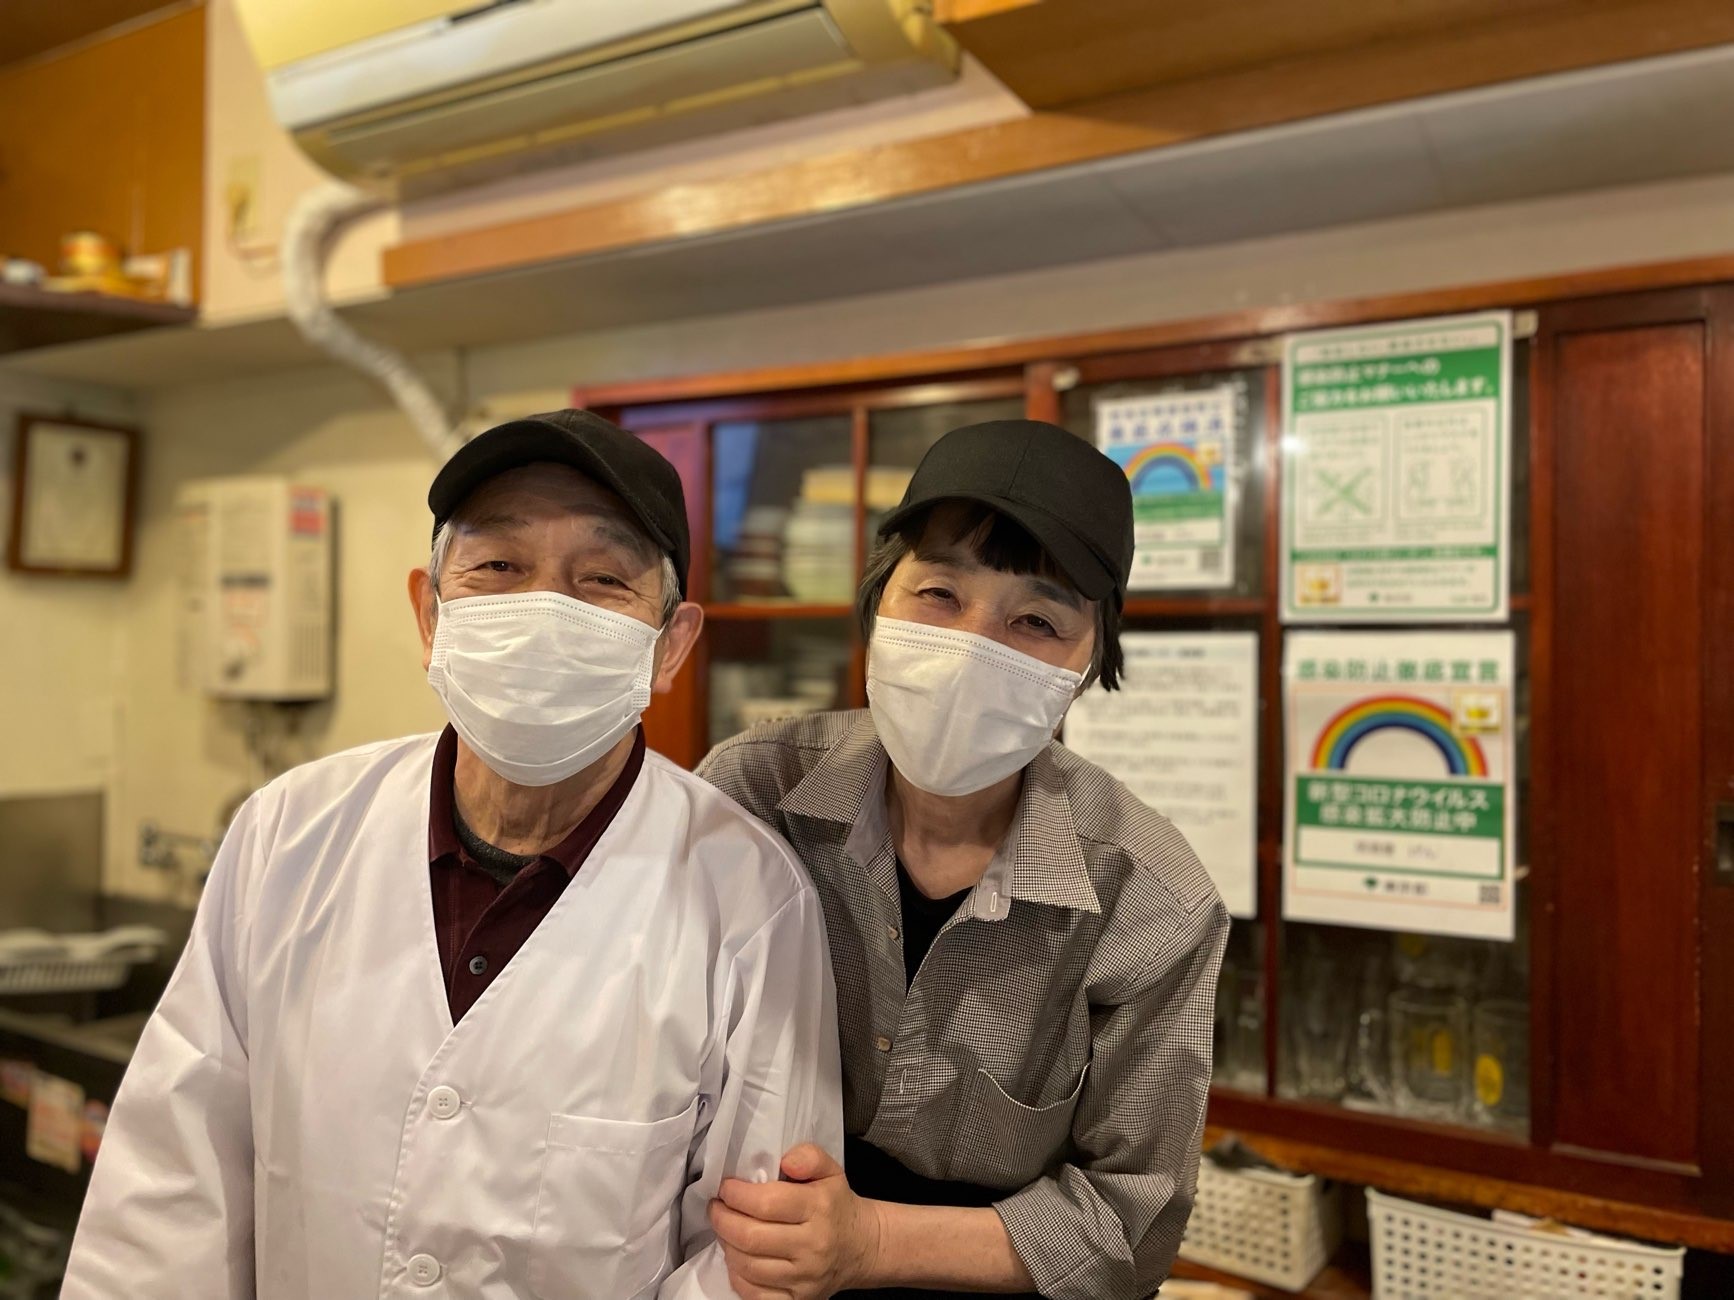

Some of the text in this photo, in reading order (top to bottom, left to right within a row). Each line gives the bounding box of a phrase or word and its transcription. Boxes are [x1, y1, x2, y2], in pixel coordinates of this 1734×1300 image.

[1298, 659, 1499, 682] 感染防止徹底宣言
[1308, 780, 1490, 810] 新型コロナウイルス
[1319, 804, 1478, 832] 感染拡大防止中
